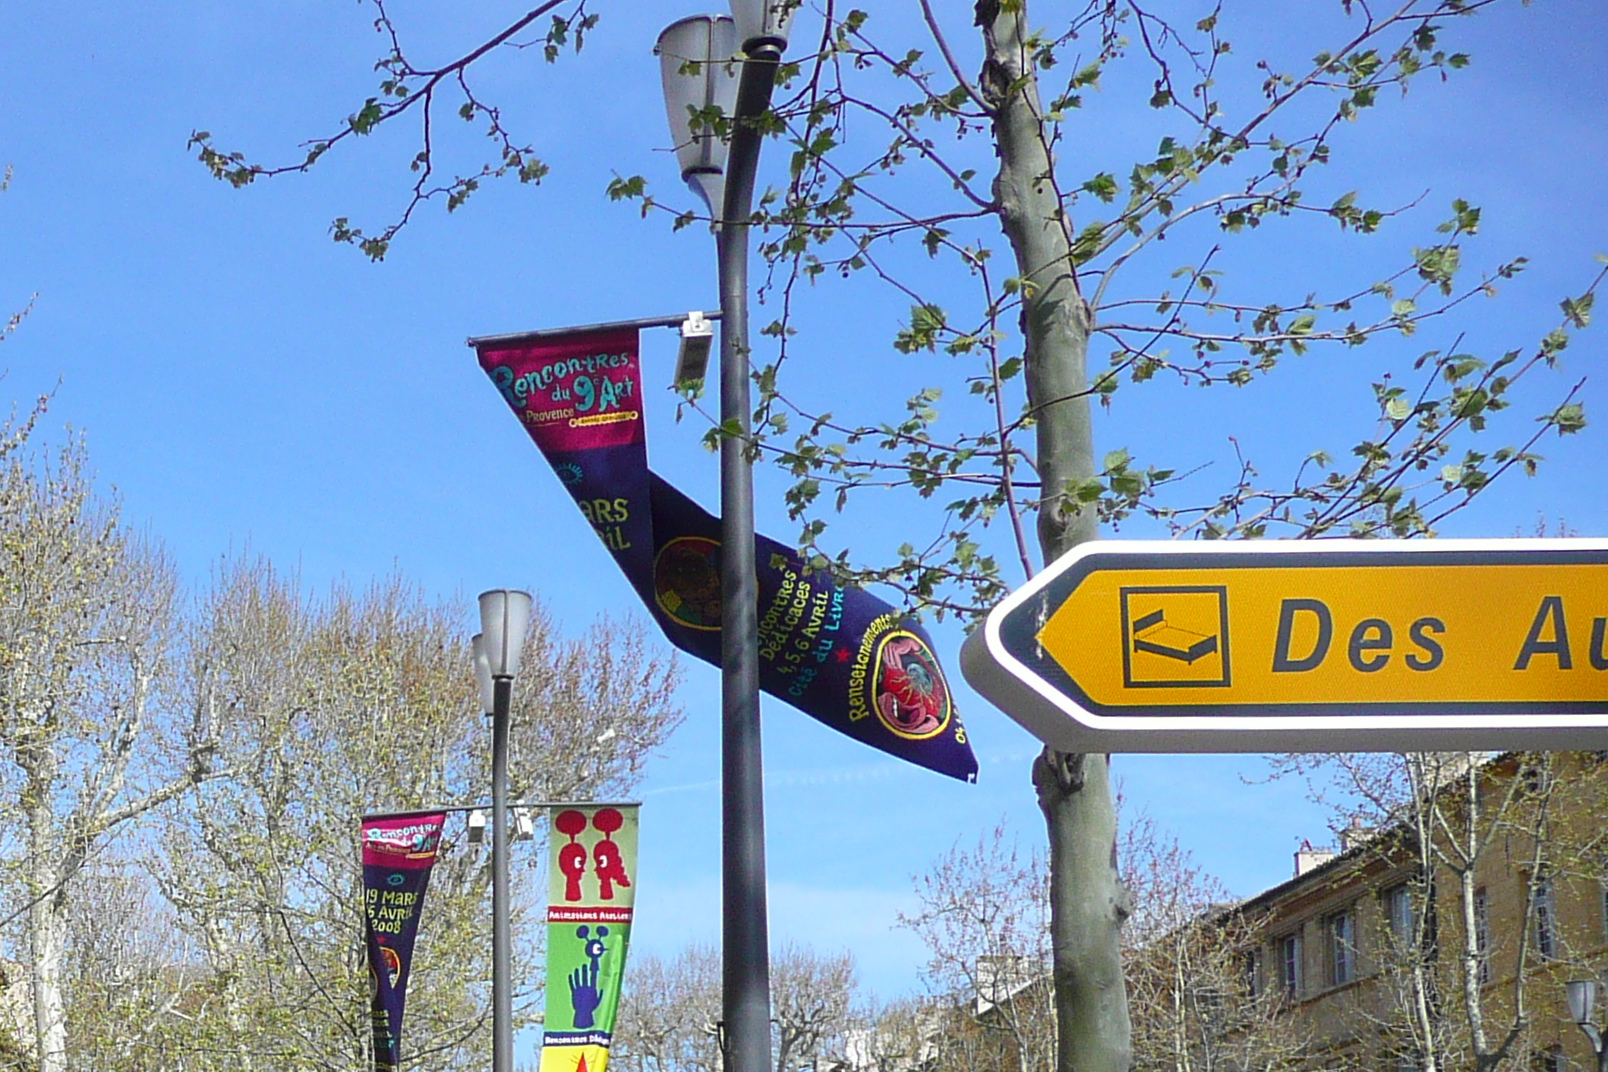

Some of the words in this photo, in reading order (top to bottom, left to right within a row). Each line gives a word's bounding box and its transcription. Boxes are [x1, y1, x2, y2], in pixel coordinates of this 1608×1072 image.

[552, 385, 571, 401] du
[1271, 598, 1446, 673] Des
[366, 889, 378, 904] 19
[372, 919, 401, 934] 2008
